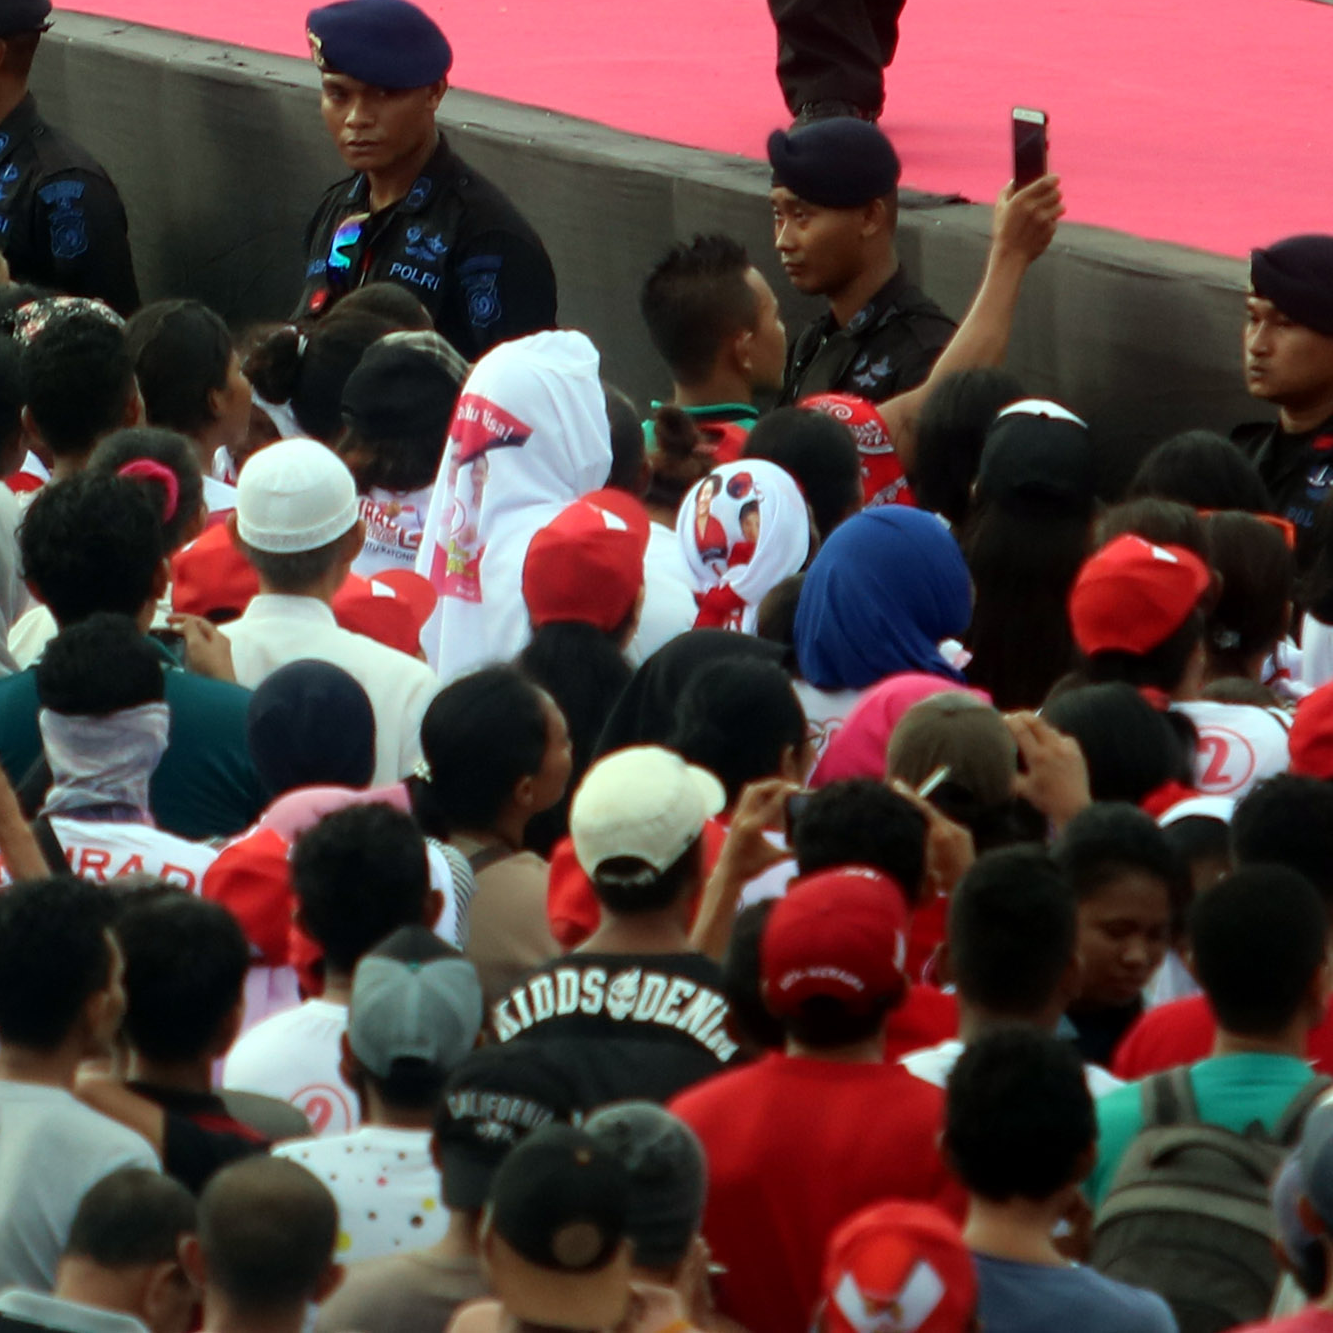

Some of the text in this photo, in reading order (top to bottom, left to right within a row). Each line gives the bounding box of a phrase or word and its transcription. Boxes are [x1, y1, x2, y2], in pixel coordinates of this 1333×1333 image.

[388, 261, 441, 292] POLRI
[1196, 736, 1233, 785] 2
[493, 968, 608, 1043] KIDDS
